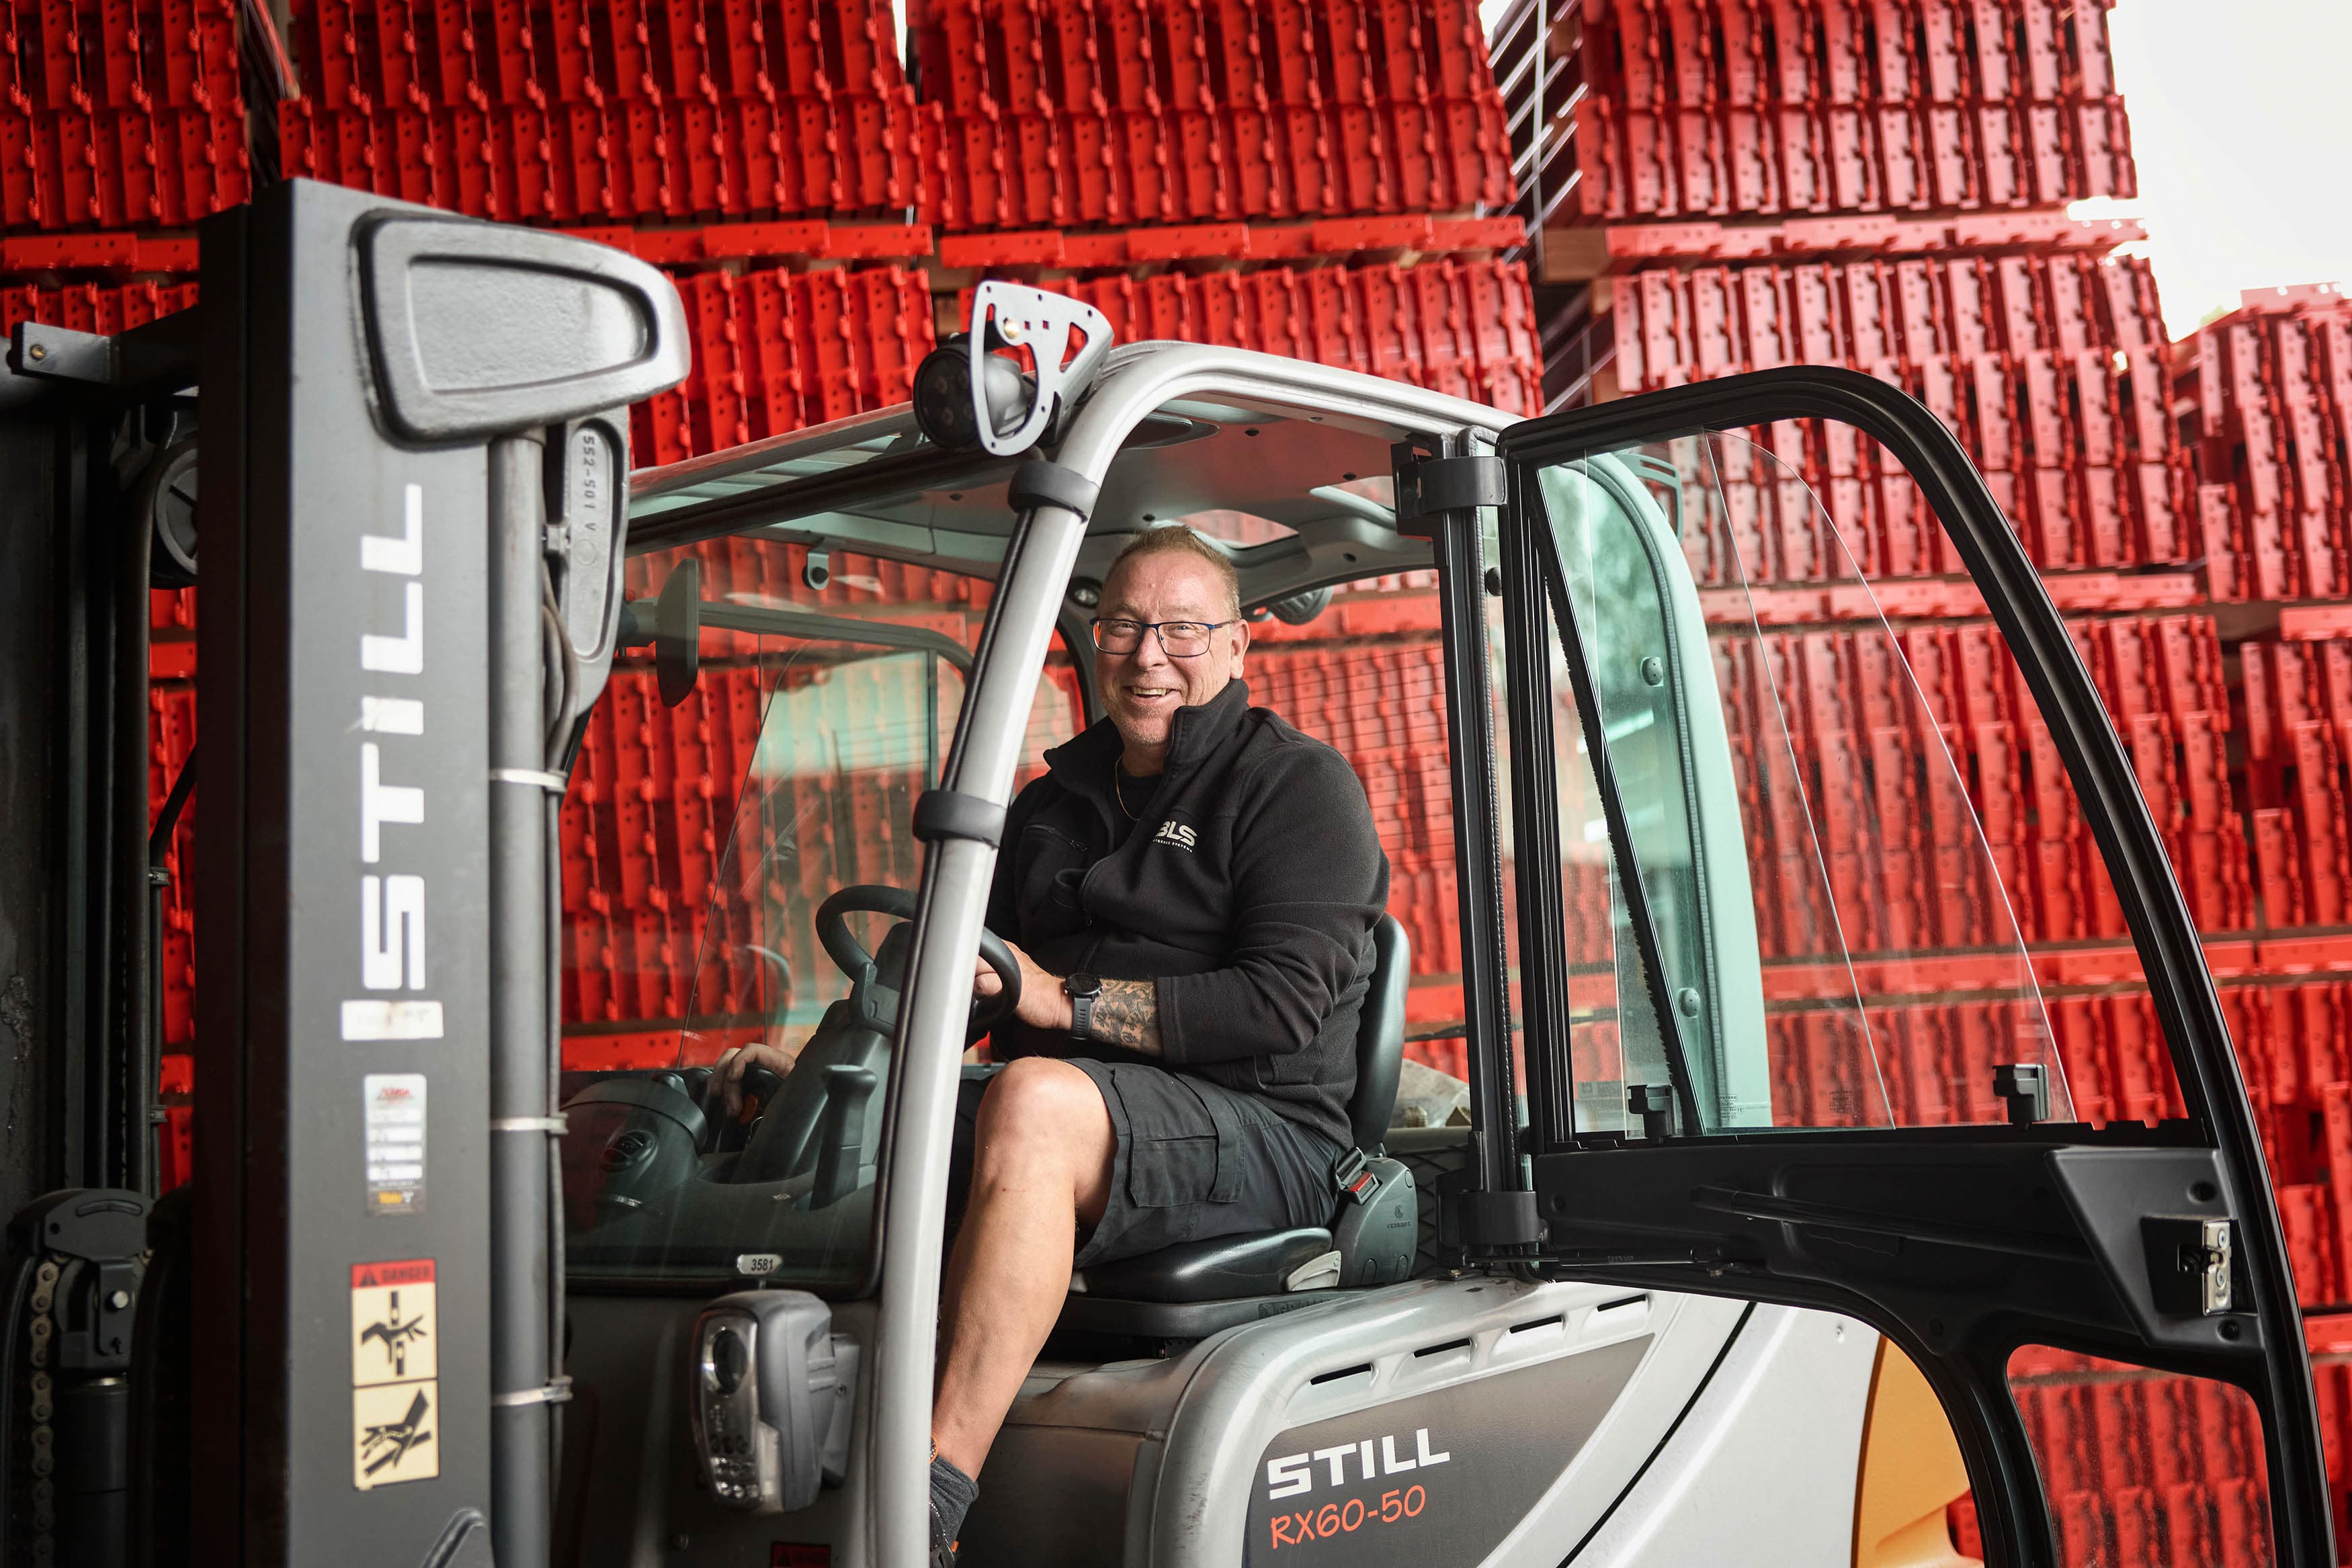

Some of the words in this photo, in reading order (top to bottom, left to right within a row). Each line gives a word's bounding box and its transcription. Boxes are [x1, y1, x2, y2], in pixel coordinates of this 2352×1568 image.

[583, 435, 596, 509] 552-501
[360, 484, 425, 991] STILL
[382, 1266, 429, 1282] DANGER
[751, 1258, 773, 1271] 3581
[1267, 1428, 1450, 1500] STILL
[1270, 1484, 1426, 1550] RX60-50
